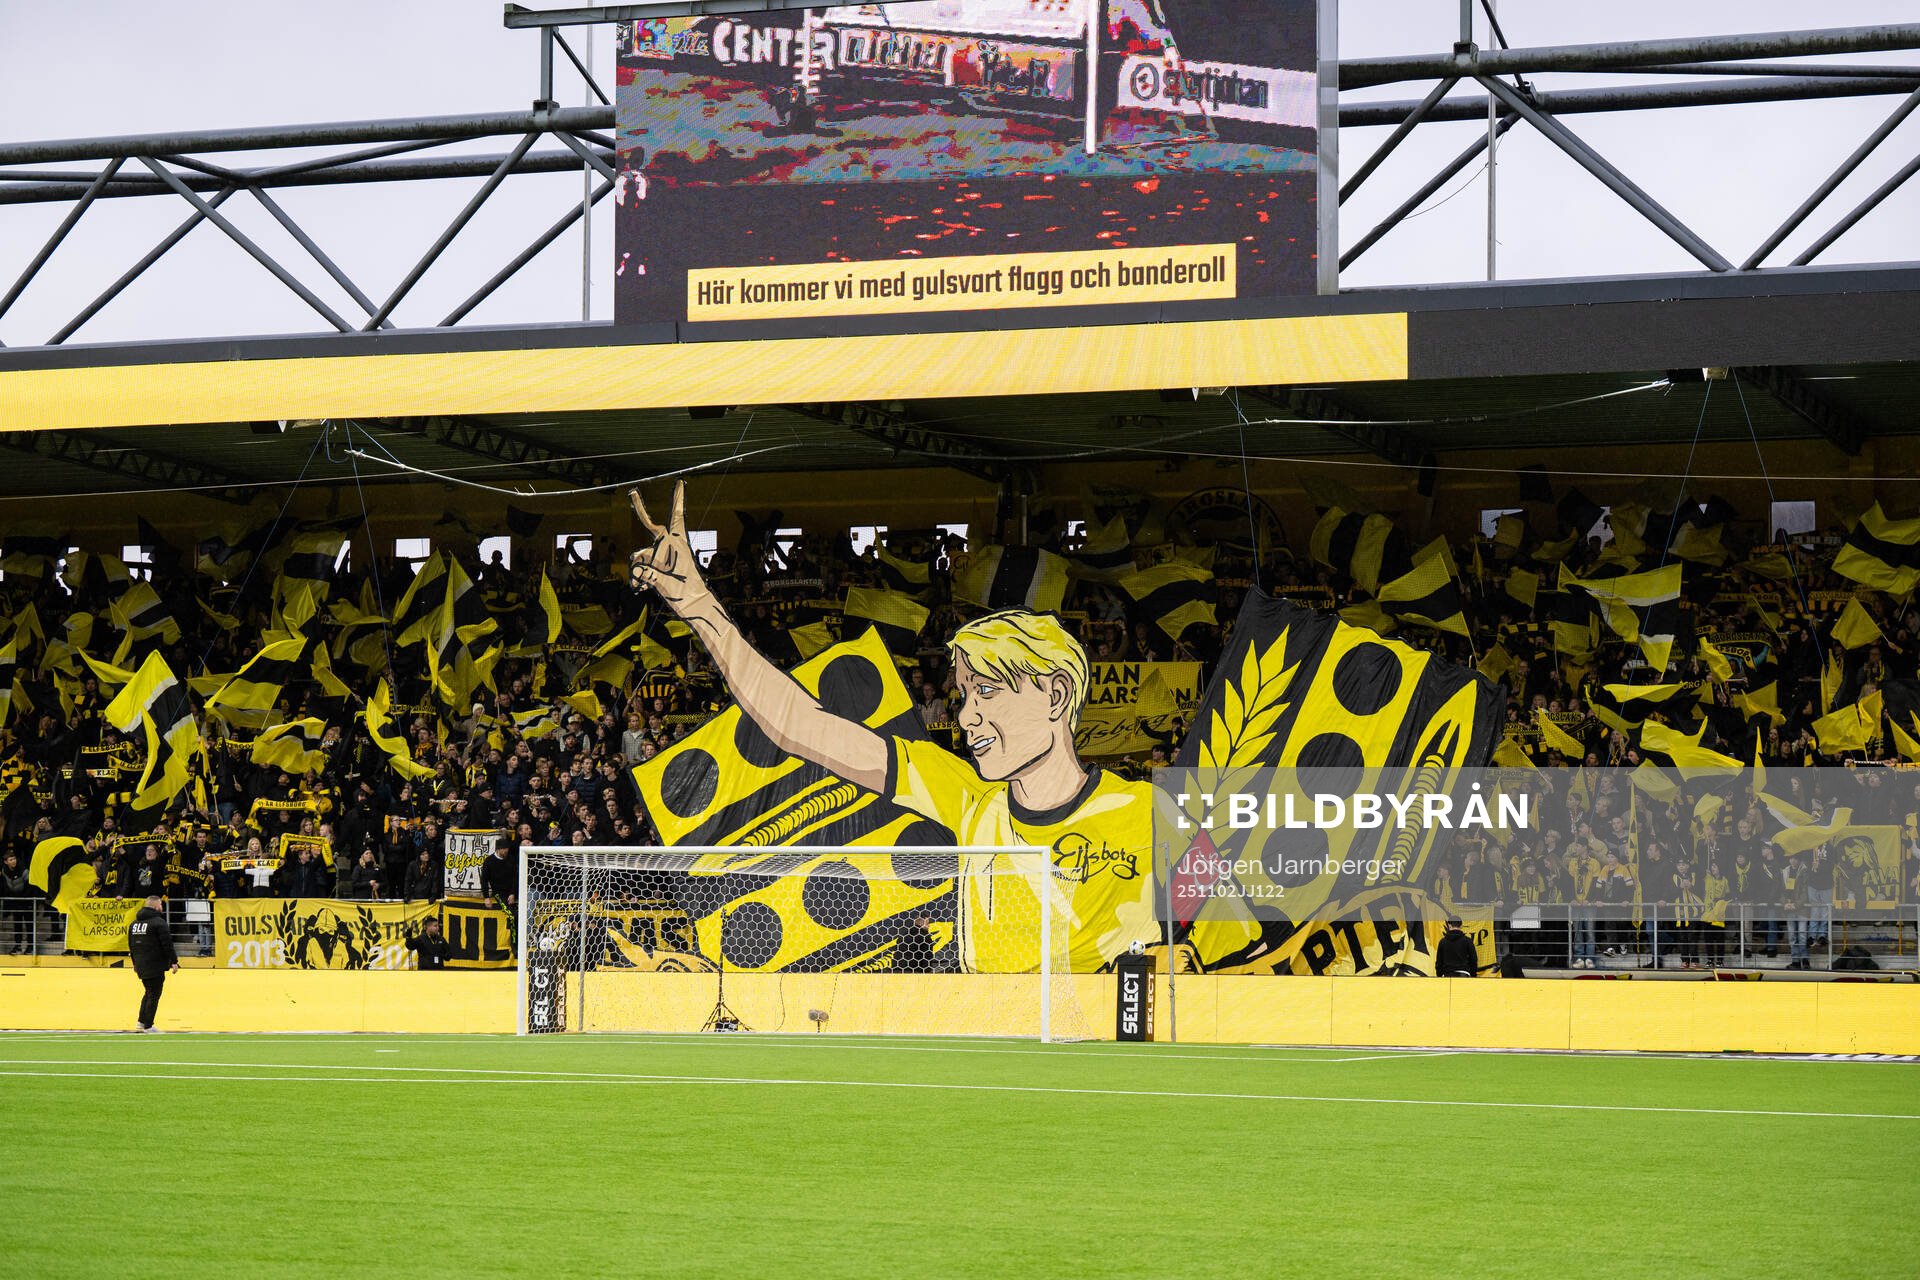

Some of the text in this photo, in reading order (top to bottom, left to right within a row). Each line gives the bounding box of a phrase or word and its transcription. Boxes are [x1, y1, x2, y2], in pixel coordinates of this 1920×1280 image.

[698, 255, 1225, 305] Här kommer vi med gulsvart flagg och banderoll
[1088, 686, 1191, 704] LARSN
[445, 853, 488, 873] Elfsbo
[82, 902, 101, 910] TACK
[120, 900, 138, 909] ALLT
[83, 925, 128, 936] LARSSON
[93, 913, 125, 926] JOHAN
[227, 939, 285, 968] 2013
[533, 966, 549, 1026] SELCT
[1122, 971, 1140, 1034] SELECT
[1146, 971, 1154, 1035] SELECT
